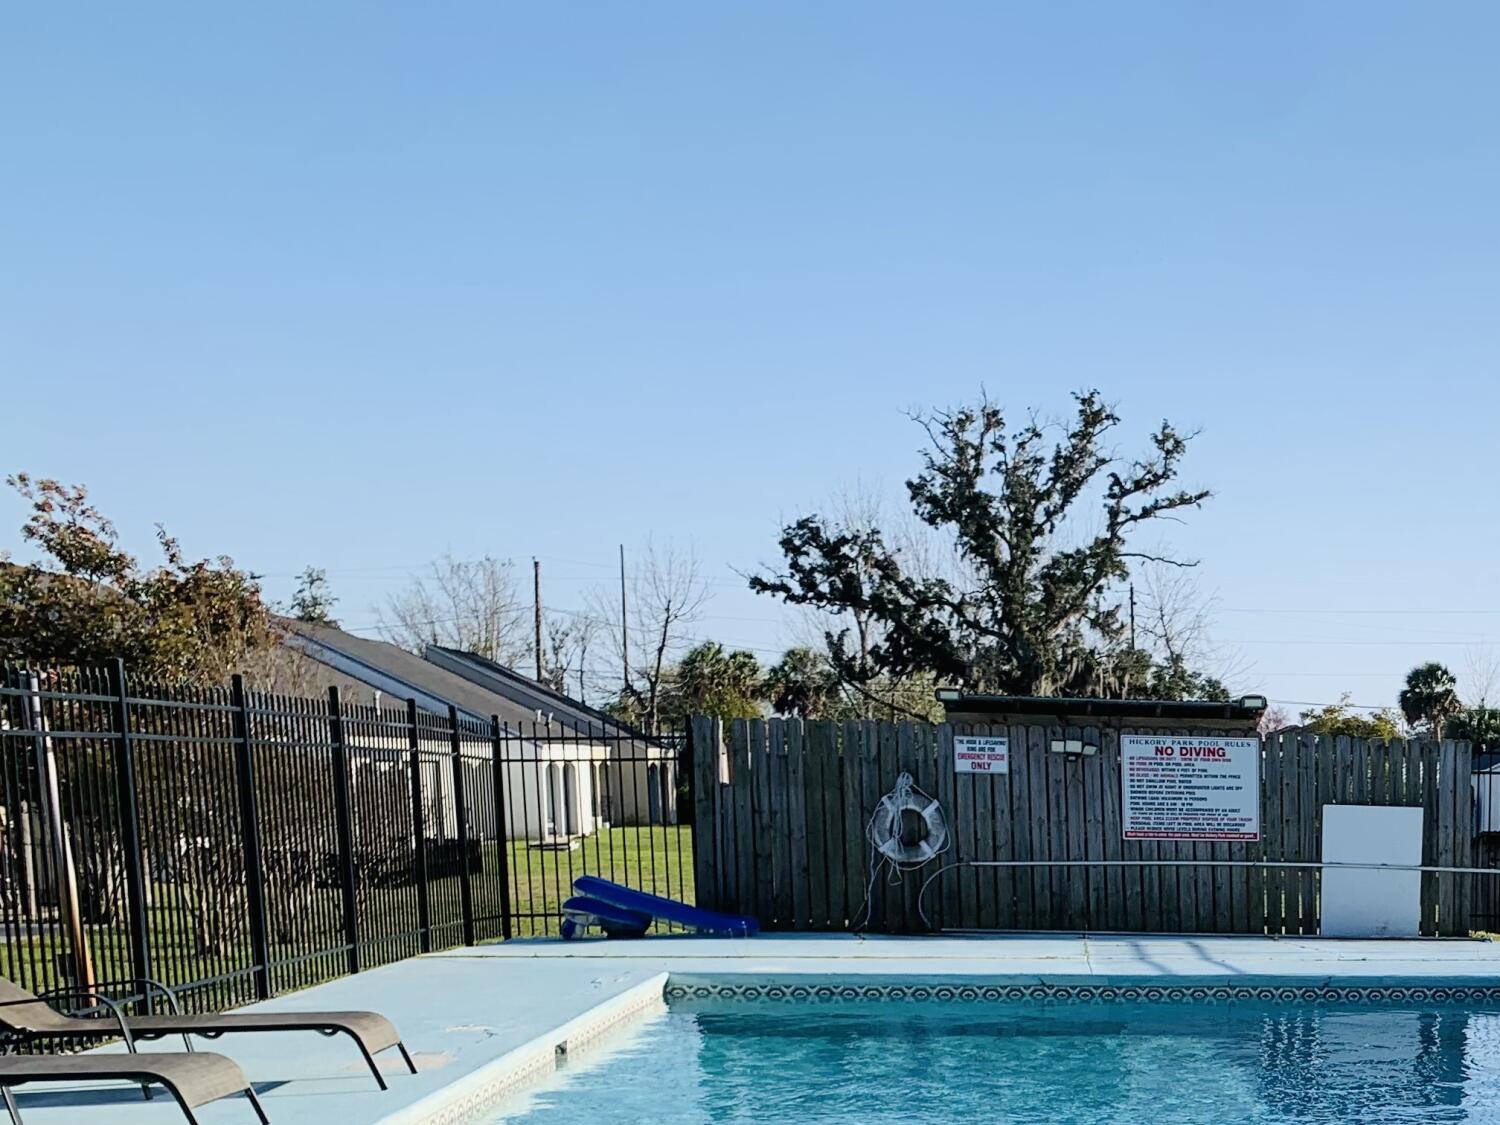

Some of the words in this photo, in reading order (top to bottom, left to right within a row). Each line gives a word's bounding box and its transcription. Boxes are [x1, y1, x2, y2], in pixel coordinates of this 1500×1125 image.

[1154, 746, 1174, 756] NO
[1179, 747, 1226, 757] DIVING
[957, 752, 985, 760] EMERGENCY
[971, 762, 992, 770] ONLY
